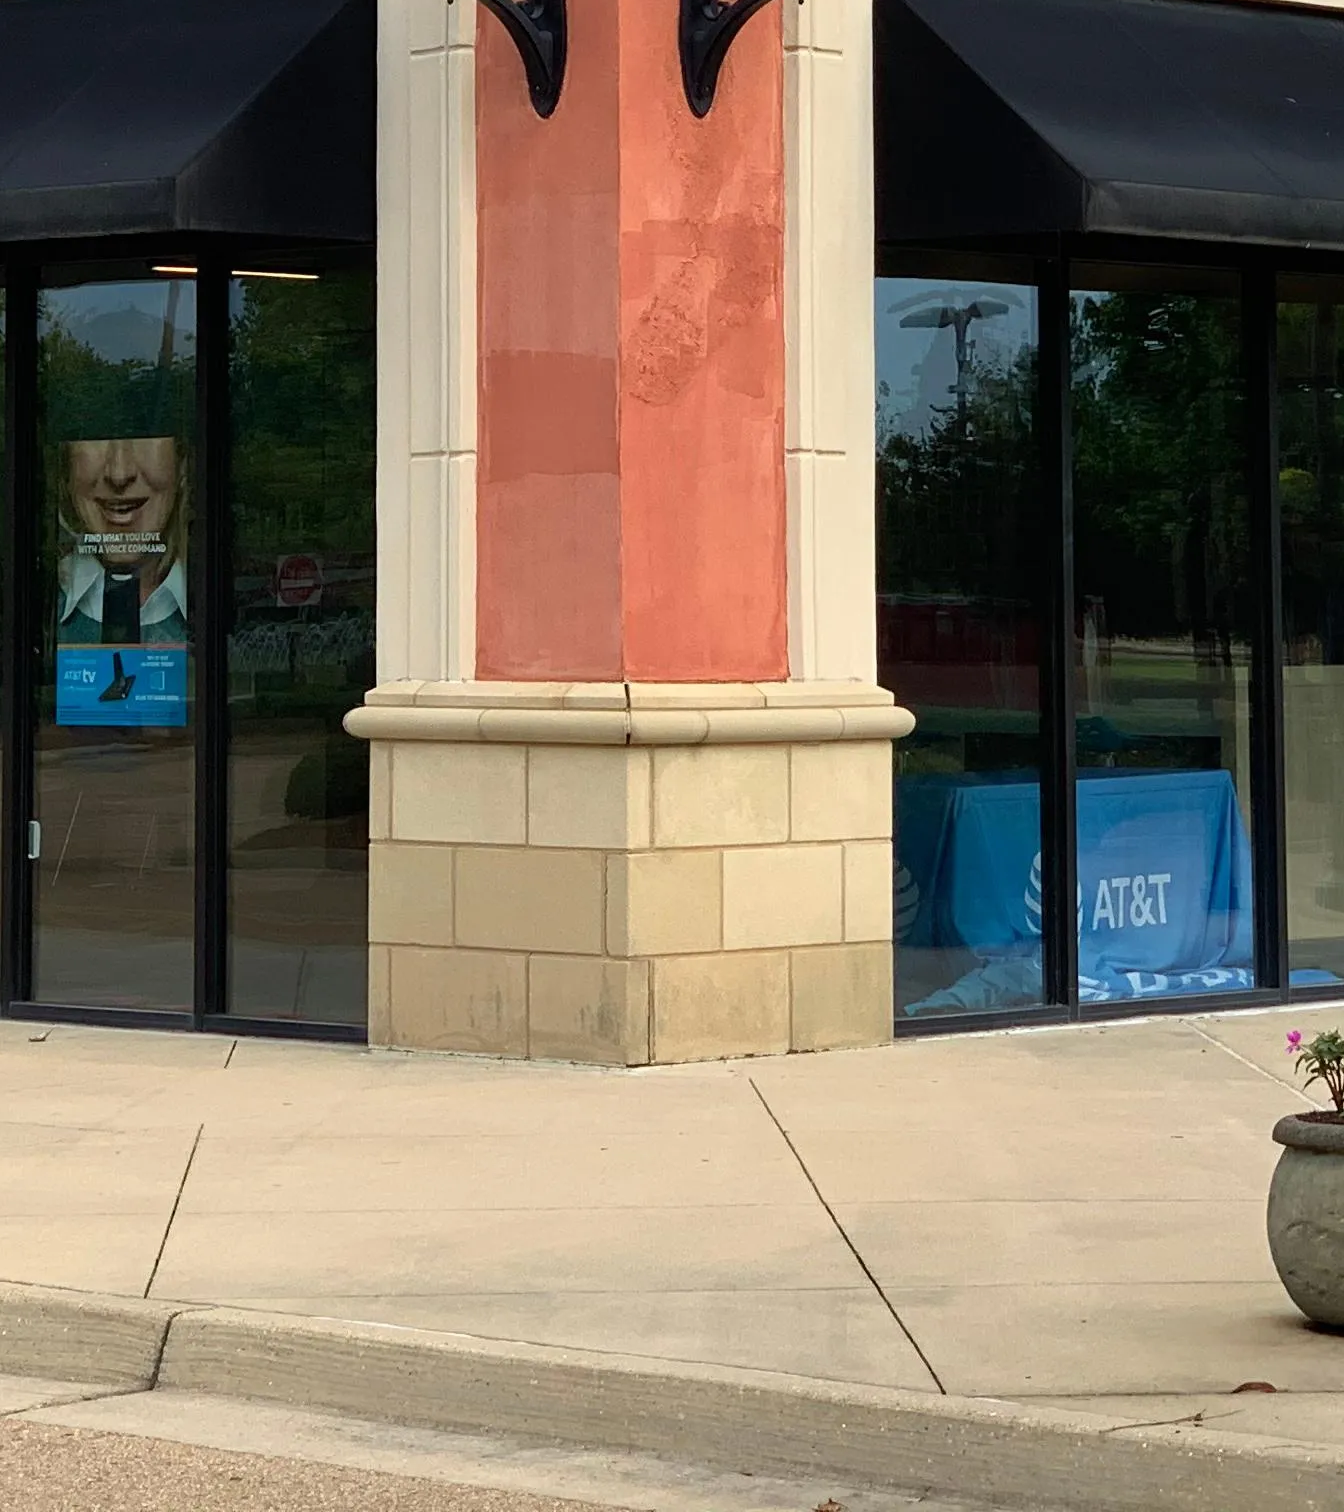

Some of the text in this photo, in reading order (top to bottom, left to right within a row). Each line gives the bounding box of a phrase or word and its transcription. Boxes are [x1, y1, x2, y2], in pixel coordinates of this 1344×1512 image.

[84, 532, 161, 543] FIND WHAT YOU LOVE
[77, 543, 167, 554] WITH A VOICE COMMAND
[82, 668, 97, 683] tv
[1092, 872, 1172, 931] AT&T
